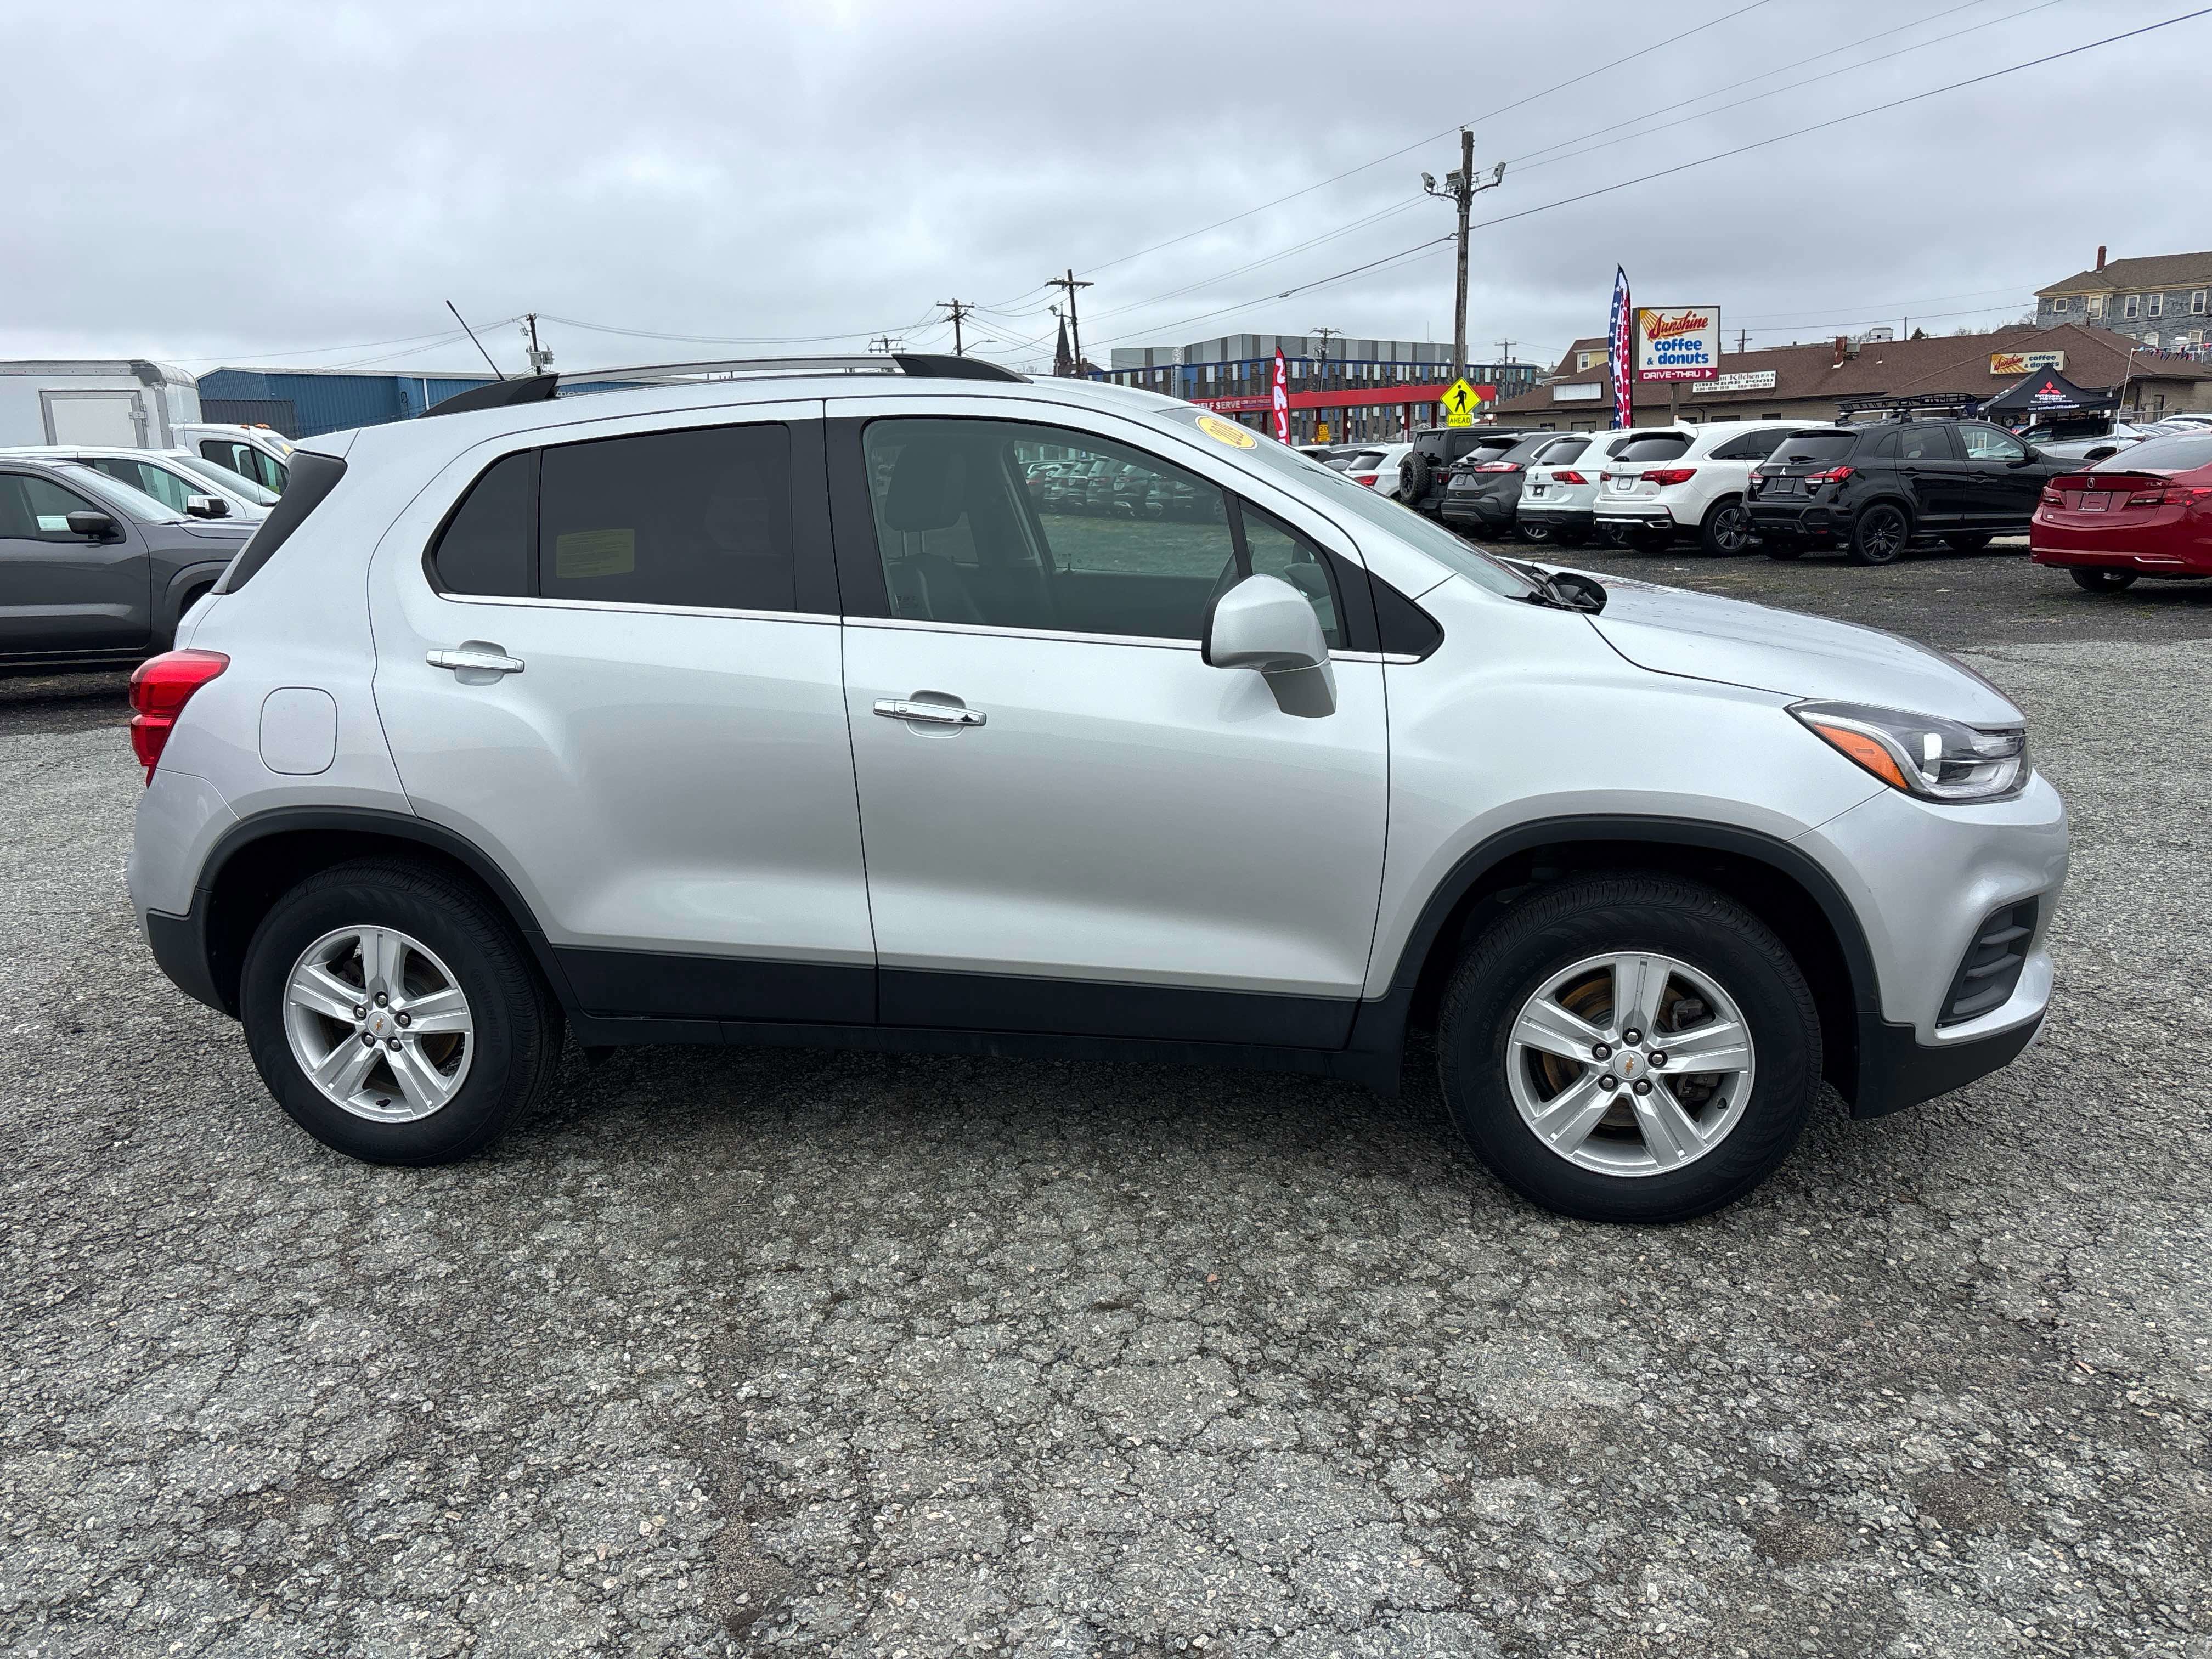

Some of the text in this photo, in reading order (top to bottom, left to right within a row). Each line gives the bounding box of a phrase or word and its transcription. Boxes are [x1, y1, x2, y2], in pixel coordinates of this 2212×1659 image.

[1649, 310, 1708, 339] Sunshine
[1654, 338, 1702, 352] coffee
[1646, 352, 1709, 365] & donuts
[1994, 354, 2024, 370] Sunshine
[1643, 370, 1701, 380] DRIVE-THRU
[1215, 400, 1240, 410] SERVE
